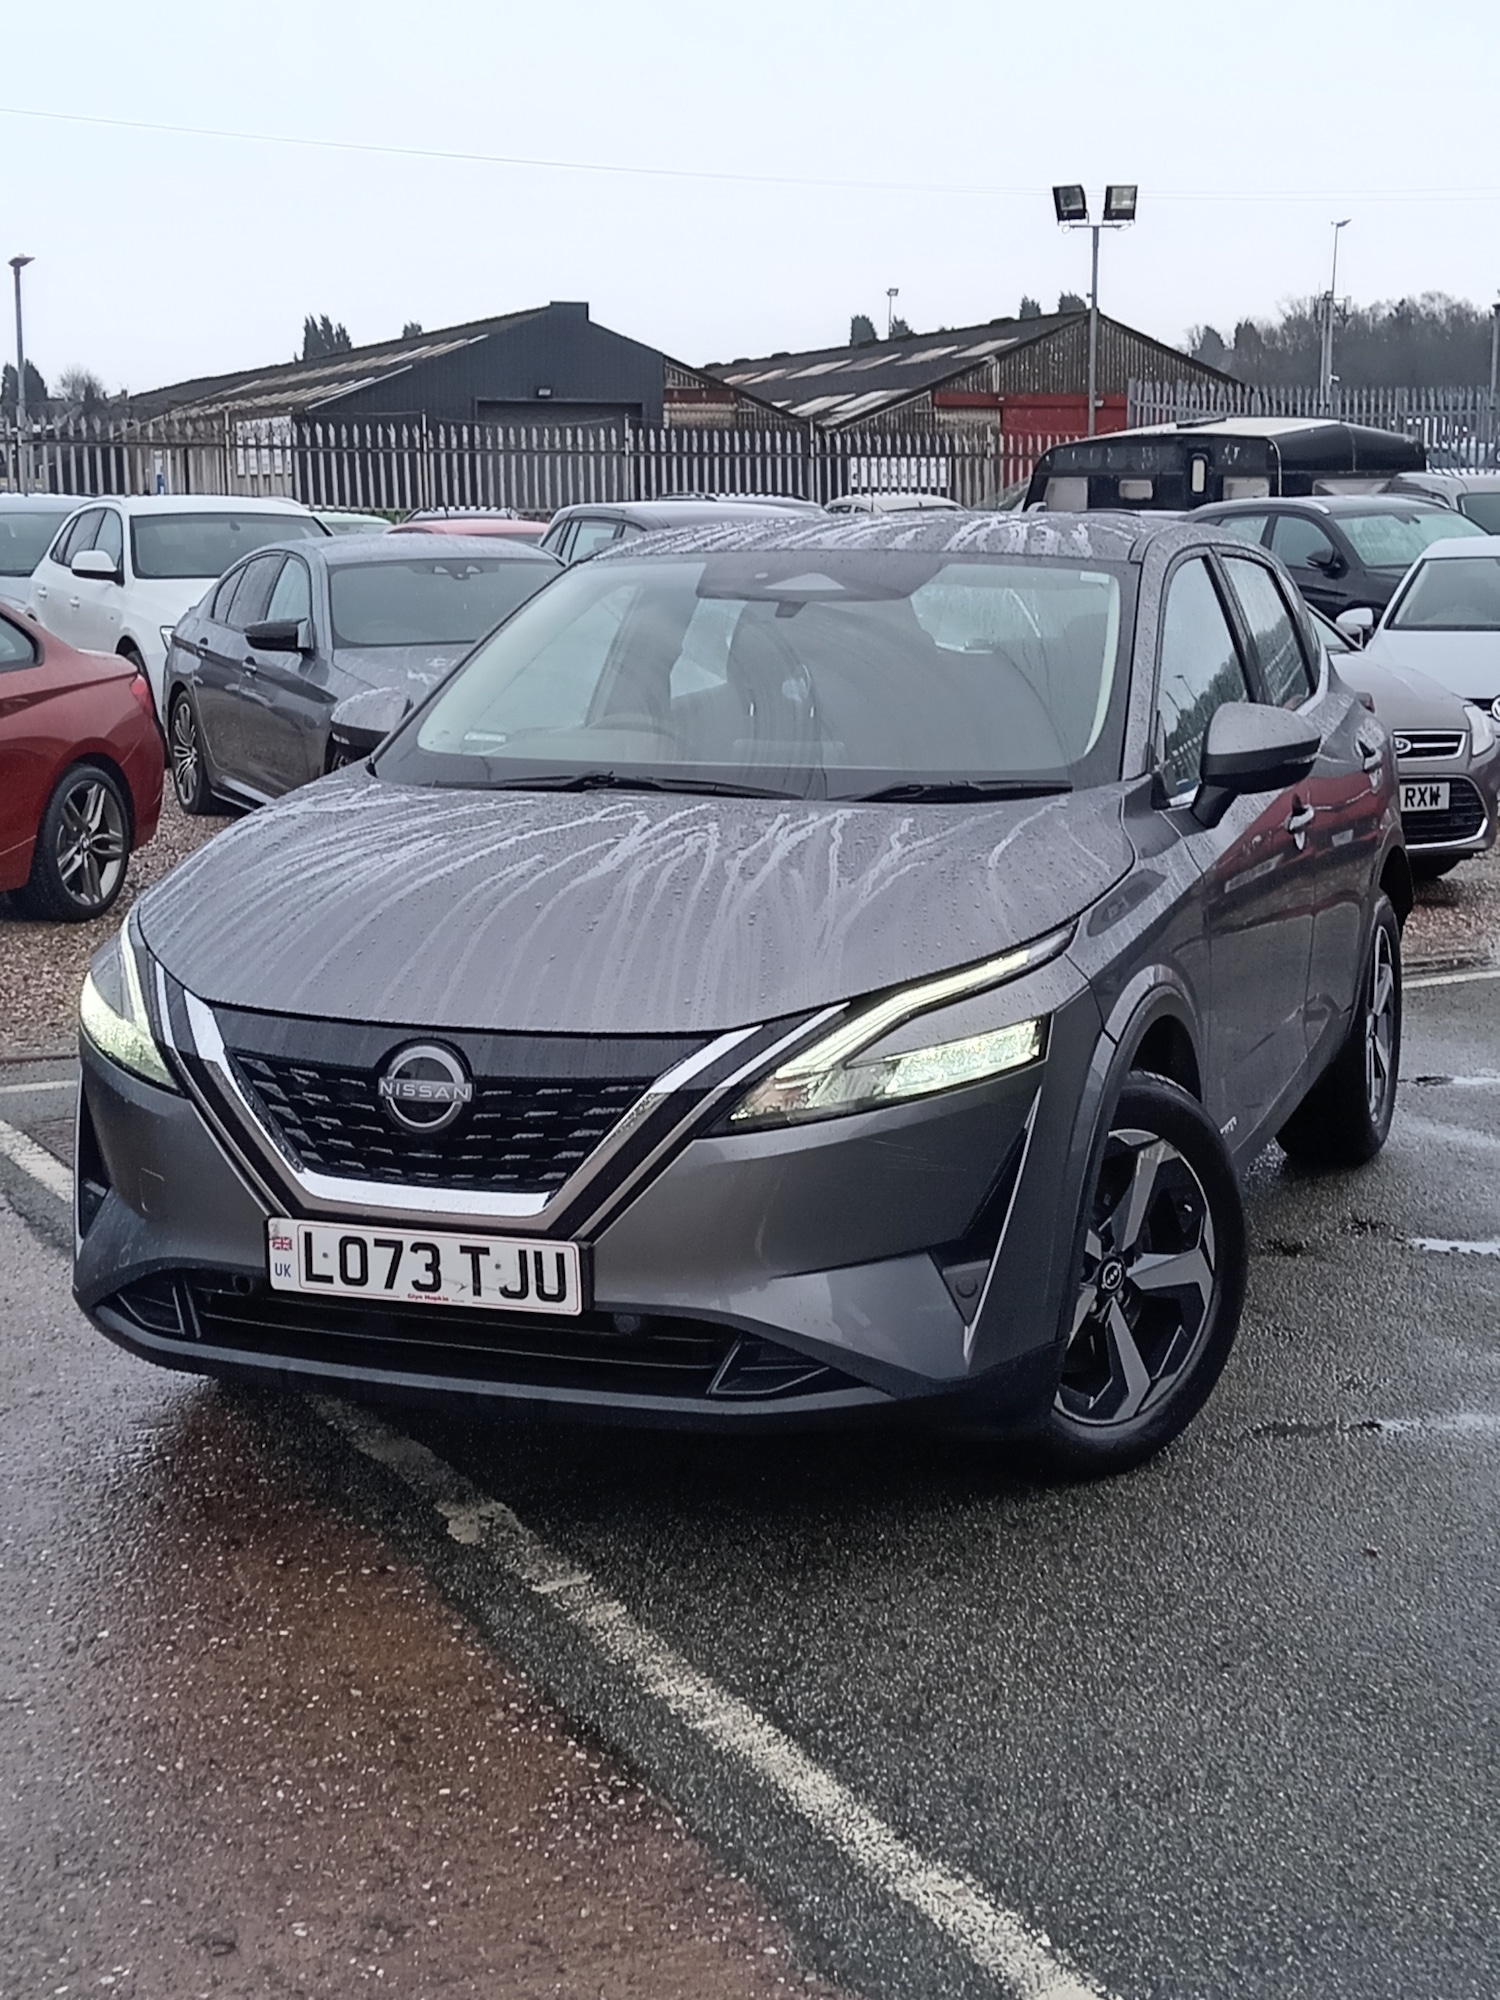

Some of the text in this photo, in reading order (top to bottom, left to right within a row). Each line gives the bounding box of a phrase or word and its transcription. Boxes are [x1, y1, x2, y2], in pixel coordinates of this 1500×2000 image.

[1405, 786, 1441, 808] RXW
[380, 1081, 469, 1100] NISSAN
[275, 1262, 291, 1278] UK
[460, 1245, 567, 1303] TJU
